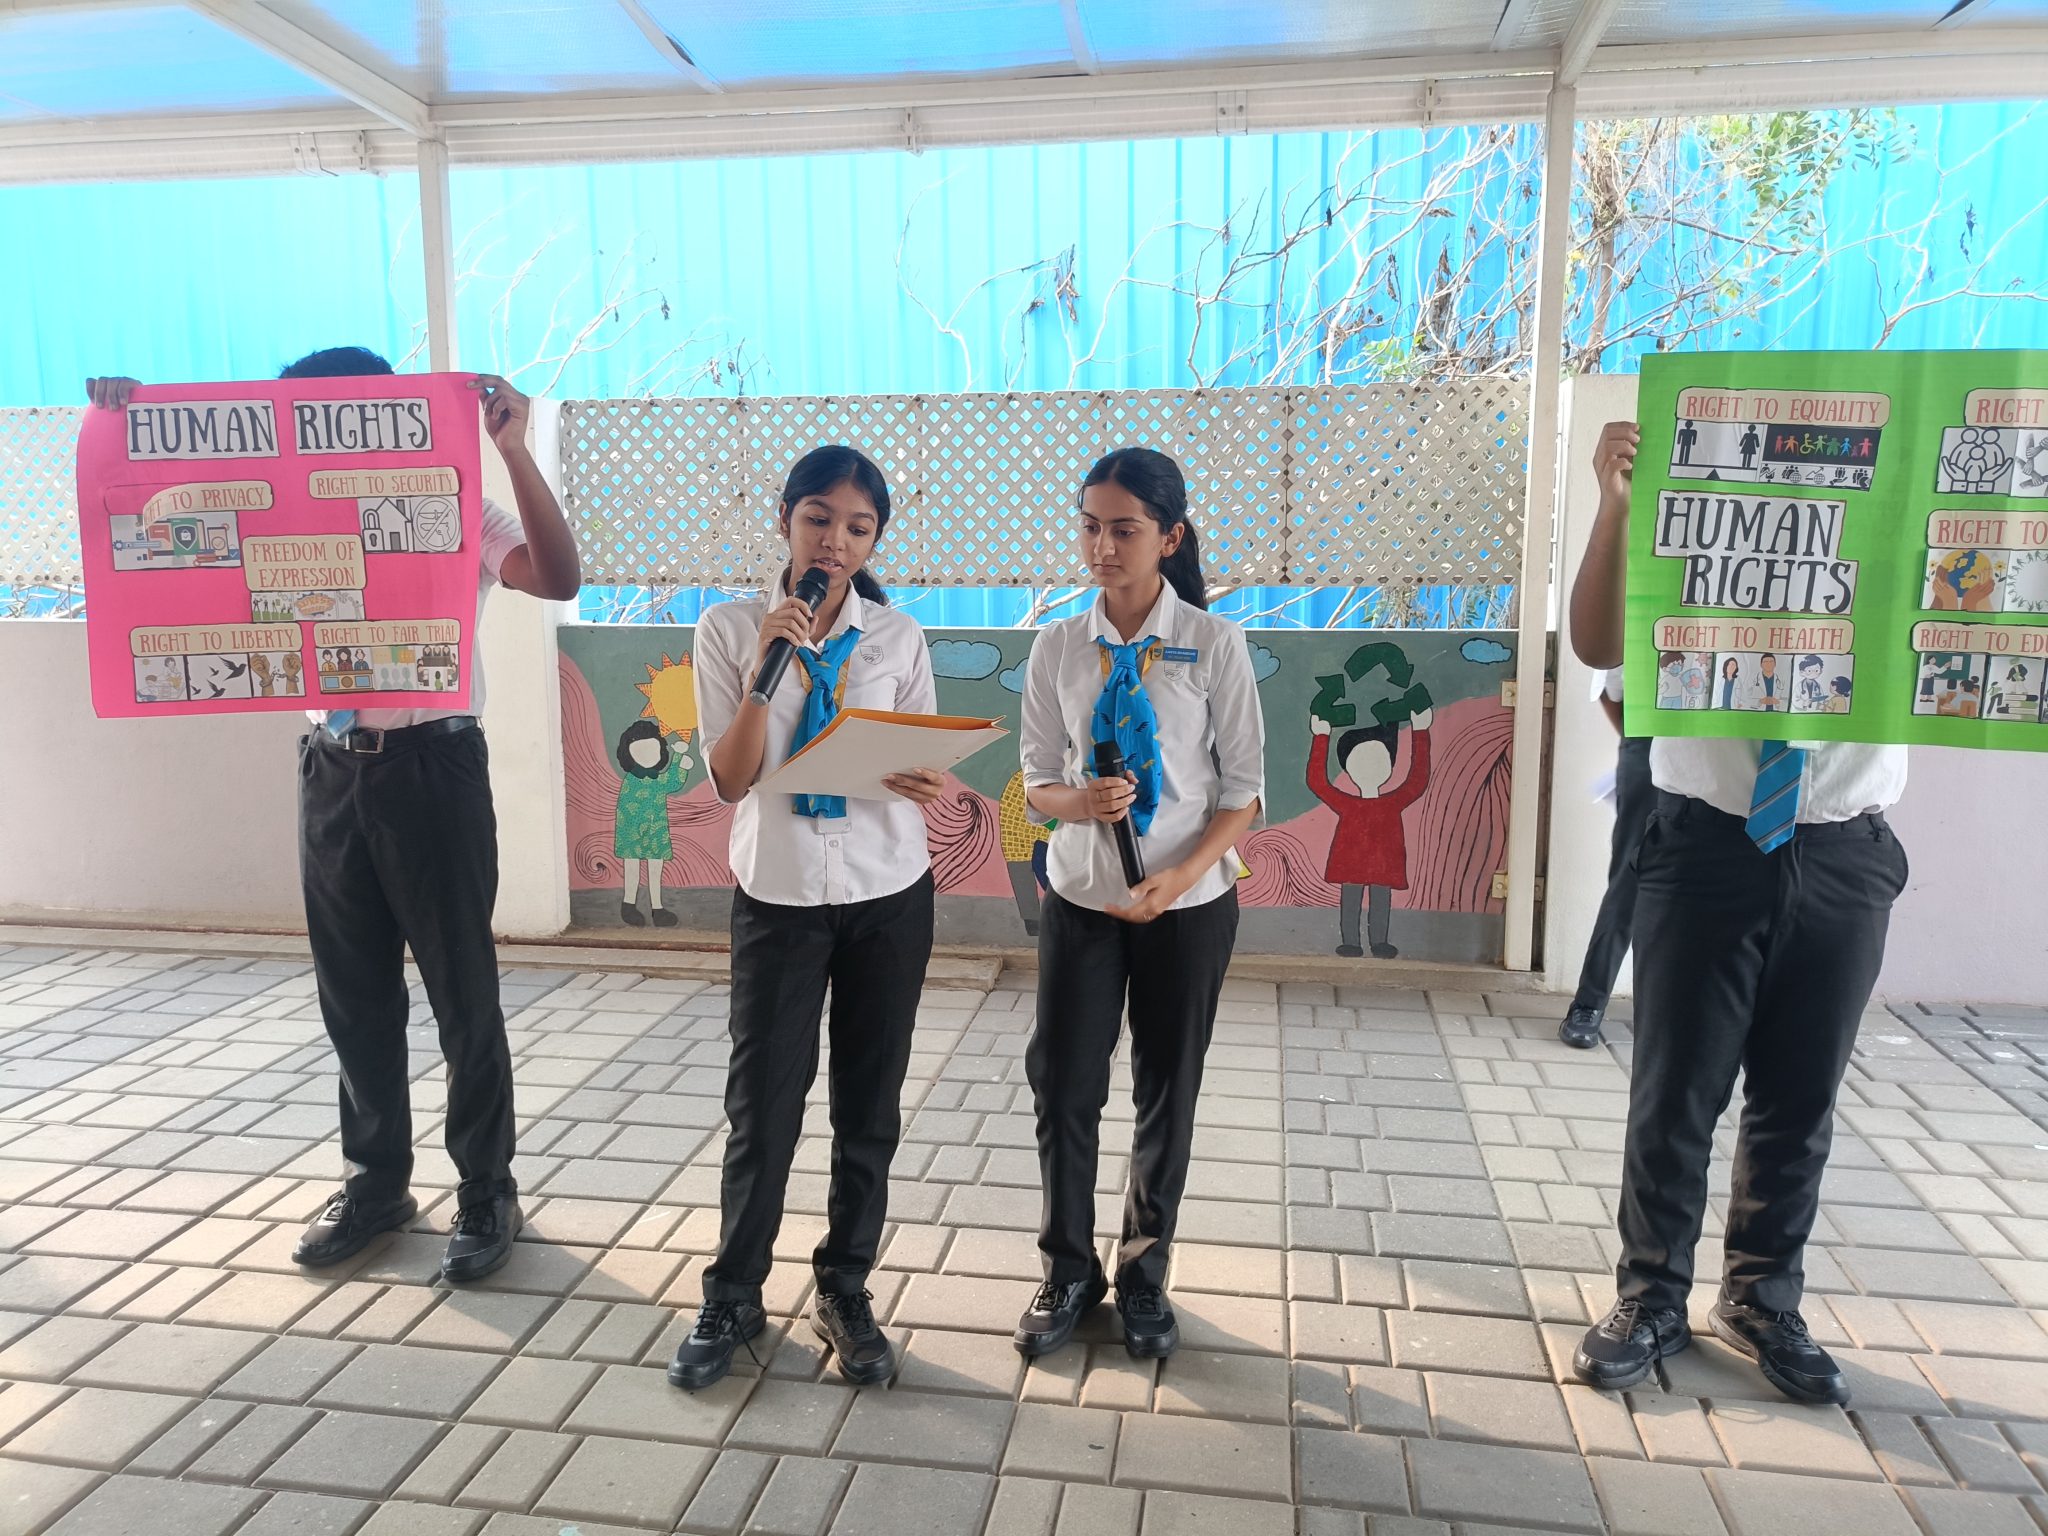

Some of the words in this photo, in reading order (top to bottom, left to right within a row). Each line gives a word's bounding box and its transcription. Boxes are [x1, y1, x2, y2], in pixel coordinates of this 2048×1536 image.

[1685, 396, 1743, 418] RIGHT
[1754, 398, 1779, 419] TO
[1789, 399, 1881, 423] EQUALITY
[1976, 398, 2045, 423] RIGHT
[128, 406, 274, 453] HUMAN
[295, 403, 428, 449] RIGHTS
[316, 477, 357, 495] RIGHT
[365, 476, 384, 494] TO
[392, 473, 455, 492] SECURITY
[169, 491, 192, 510] TO
[201, 487, 265, 508] PRIVACY
[1659, 497, 1839, 557] HUMAN
[1937, 519, 2008, 544] RIGHT
[2020, 520, 2048, 544] TO
[251, 542, 327, 562] FREEDOM
[336, 541, 356, 560] OF
[259, 567, 355, 587] EXPRESSION
[1683, 554, 1851, 613] RIGHTS
[139, 632, 190, 652] RIGHT
[200, 631, 222, 649] TO
[232, 628, 295, 648] LIBERTY
[321, 627, 360, 644] RIGHT
[368, 626, 385, 642] TO
[392, 625, 420, 642] FAIR
[426, 625, 456, 641] TRIAL
[1663, 625, 1720, 647] RIGHT
[1731, 626, 1757, 648] TO
[1768, 627, 1844, 649] HEALTH
[1920, 628, 1973, 649] RIGHT
[1985, 631, 2009, 651] TO
